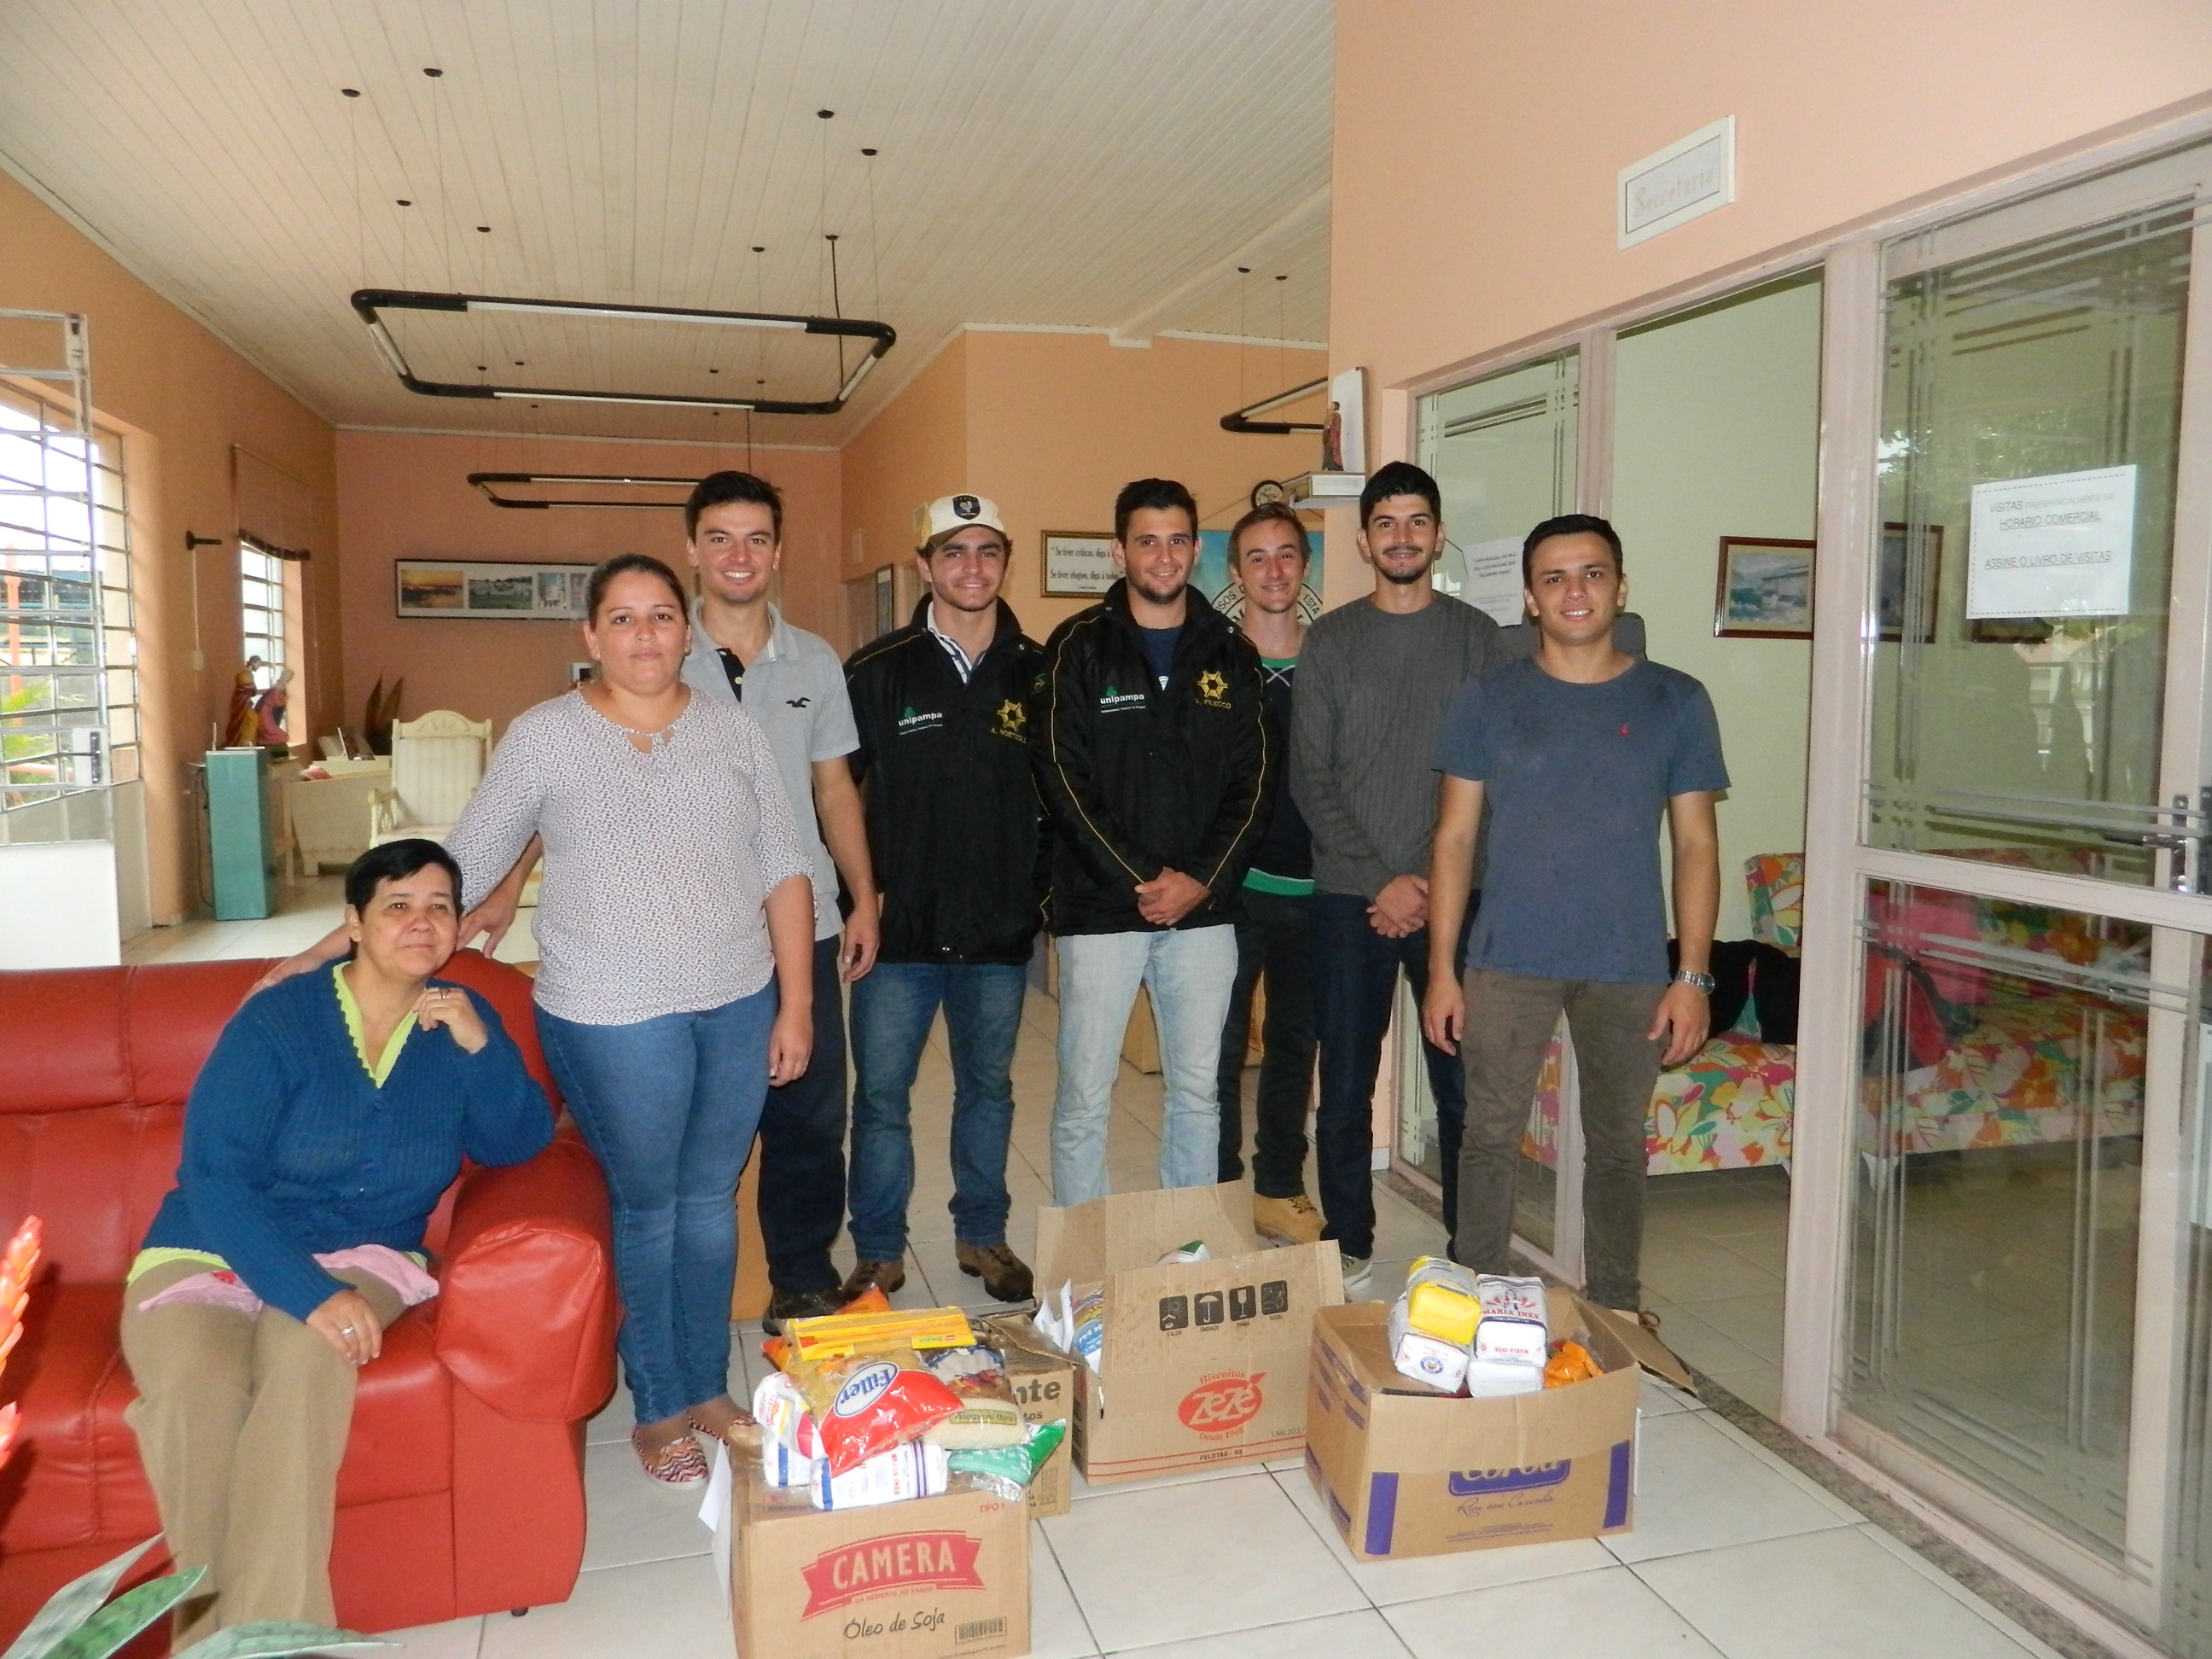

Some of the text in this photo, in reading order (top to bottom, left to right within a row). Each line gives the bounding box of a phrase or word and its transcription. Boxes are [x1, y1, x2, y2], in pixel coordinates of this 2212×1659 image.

[1635, 169, 1714, 218] Secretaria
[1989, 500, 2023, 513] VISITAS
[2045, 510, 2100, 526] COMERCIAL
[1984, 550, 2111, 569] ASSINE O LIVRO DE VISITAS
[1100, 693, 1144, 705] unipampa
[899, 711, 943, 727] unipampa
[1200, 1368, 1245, 1384] Biscoitos
[840, 1368, 893, 1405] Filler
[1199, 1450, 1228, 1461] PELOTAS
[979, 1502, 999, 1514] TIPO
[833, 1540, 956, 1590] CAMERA
[843, 1607, 946, 1639] Óleo de Soja
